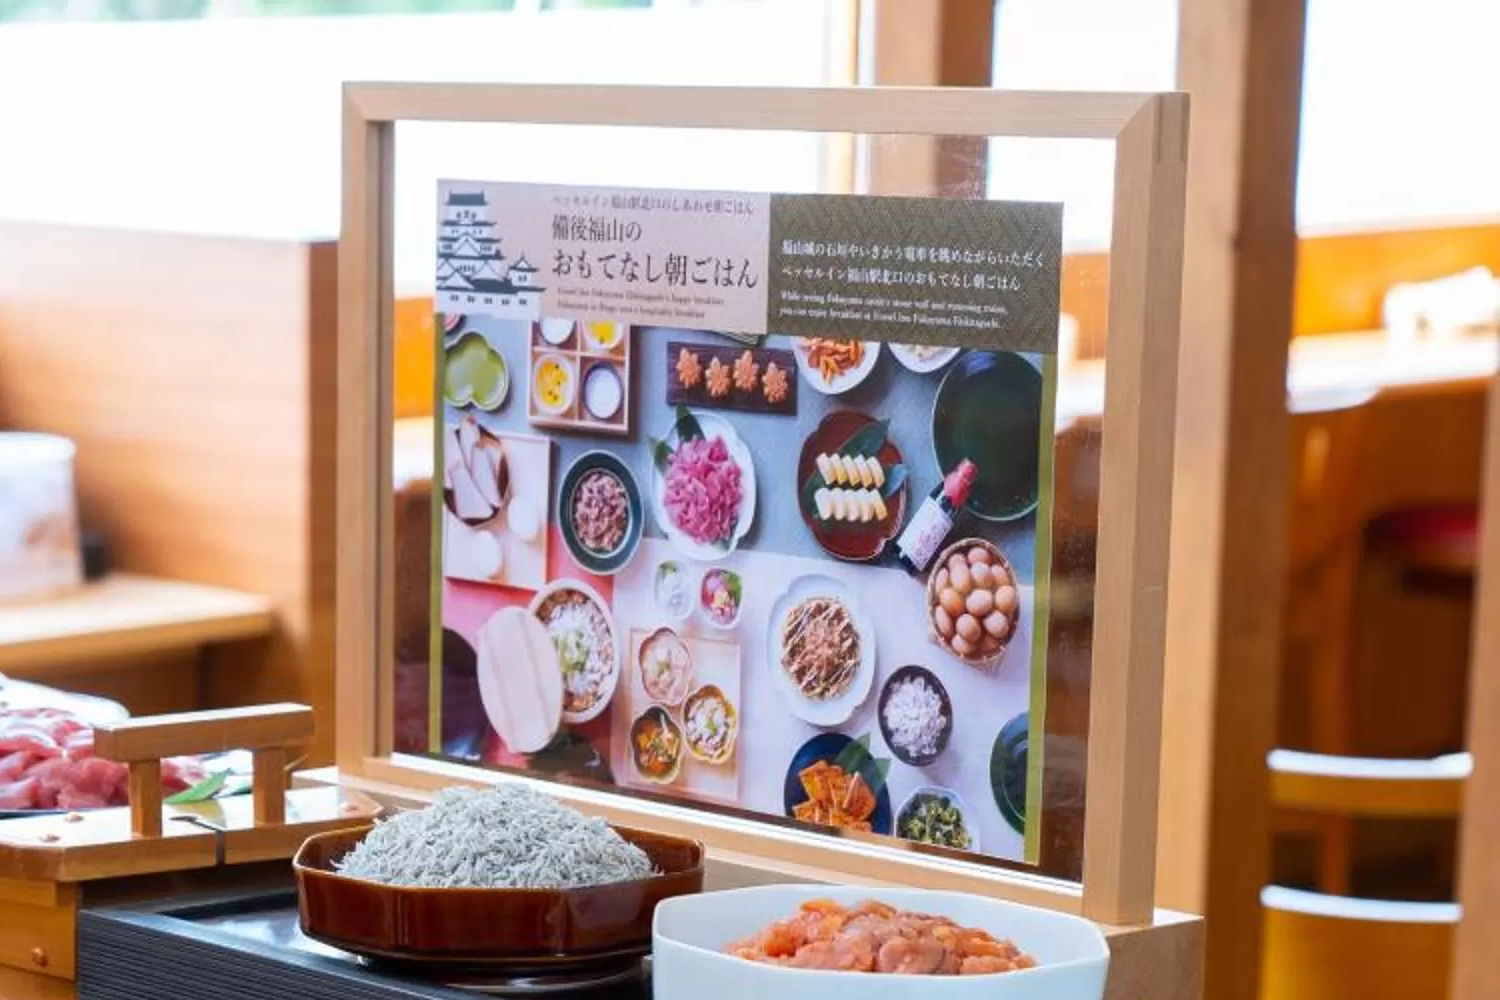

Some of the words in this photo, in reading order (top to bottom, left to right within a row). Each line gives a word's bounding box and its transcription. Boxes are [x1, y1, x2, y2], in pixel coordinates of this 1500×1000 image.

[551, 214, 643, 243] 備後福山の
[552, 249, 758, 289] おもてなし朝ごはん
